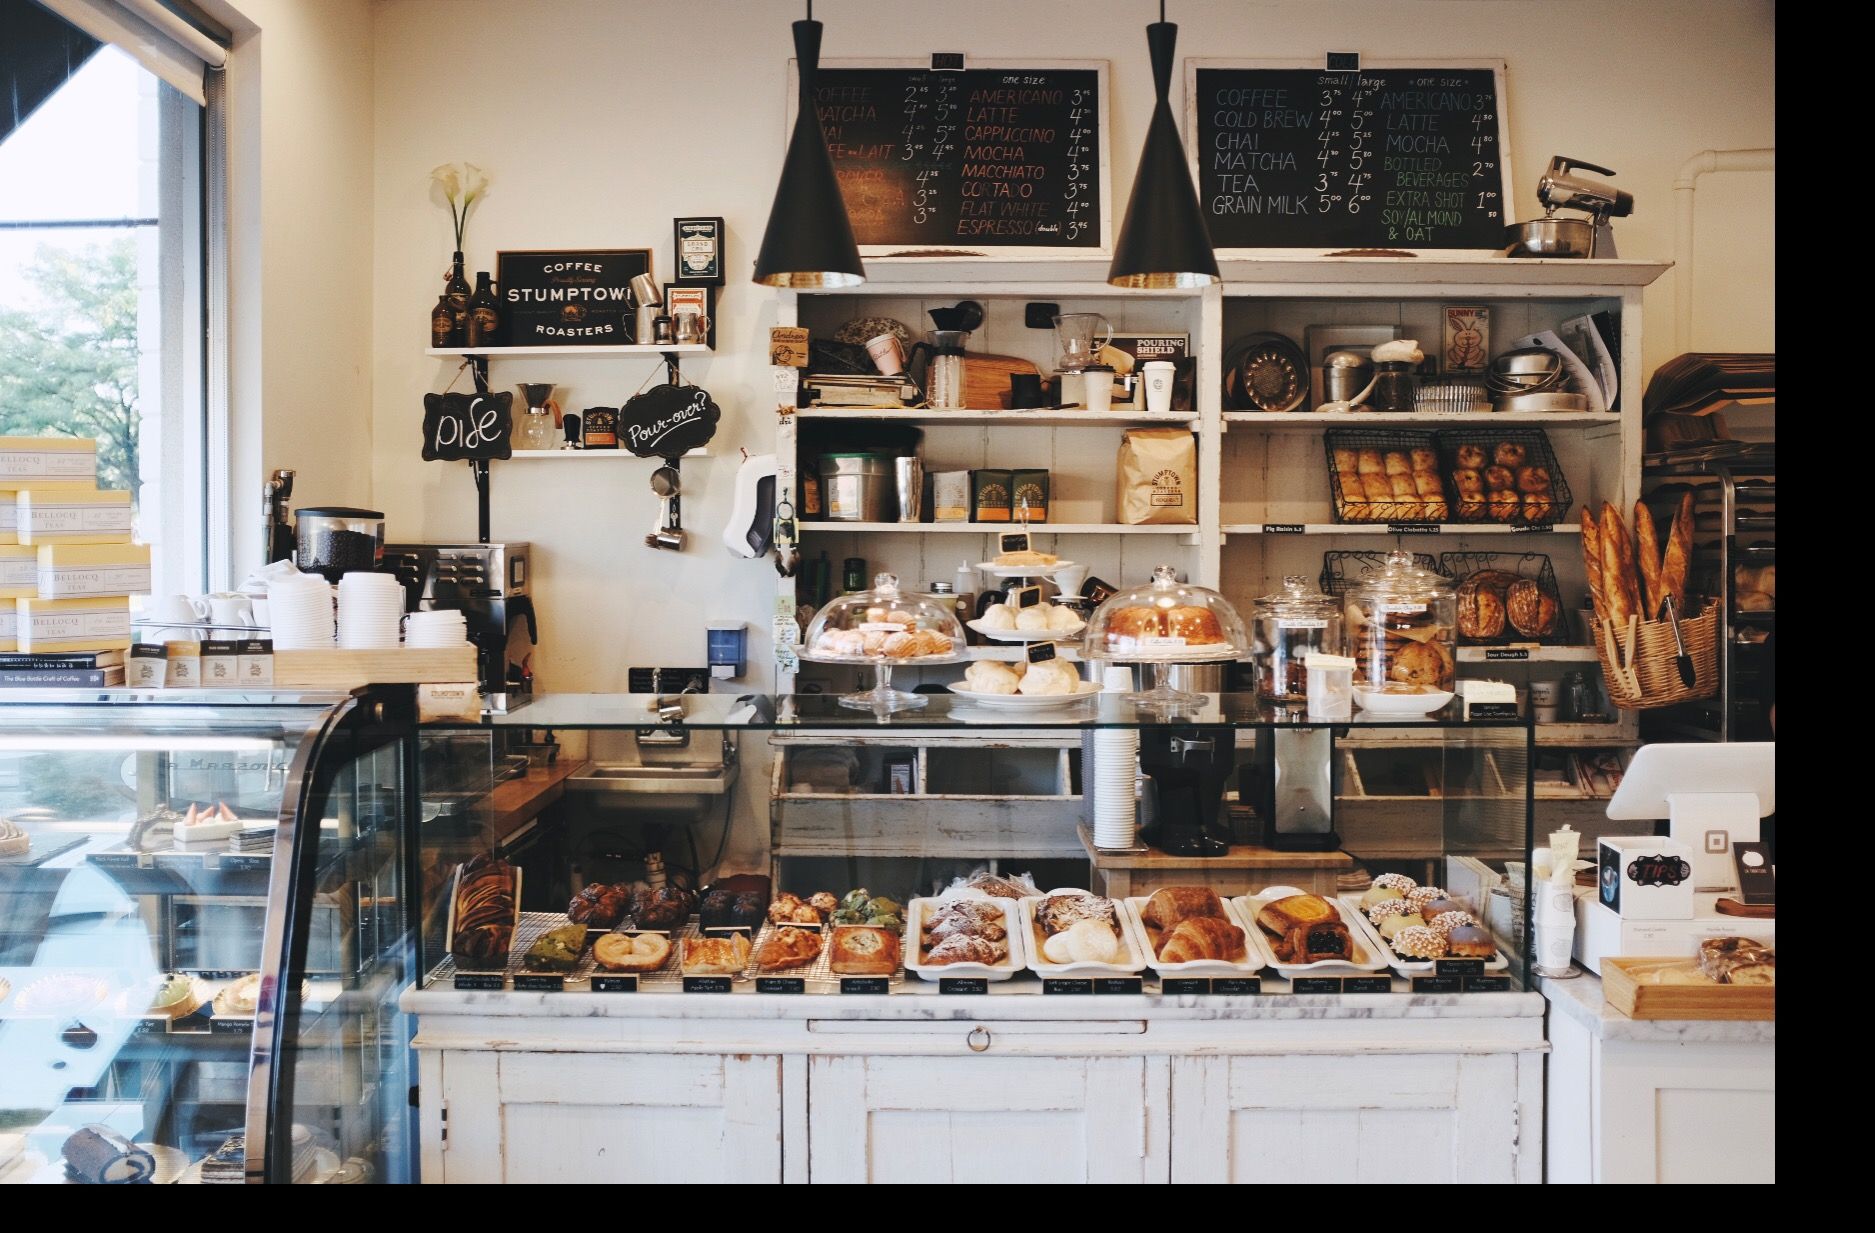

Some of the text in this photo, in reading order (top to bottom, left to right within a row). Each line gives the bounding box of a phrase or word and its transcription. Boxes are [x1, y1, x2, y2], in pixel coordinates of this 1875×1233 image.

[1002, 75, 1045, 85] one size
[1317, 73, 1387, 91] small large
[1416, 77, 1463, 87] one size
[815, 86, 873, 103] OFFEE
[969, 88, 1064, 105] AMERICANO
[1215, 88, 1289, 109] COFFEE
[1379, 91, 1472, 111] AMERICANO
[966, 106, 1020, 123] LATTE
[1213, 110, 1257, 129] COLD
[1263, 109, 1314, 129] BREW
[1385, 113, 1441, 132] LATTE
[964, 124, 1057, 144] CAPPUCCINO
[1214, 131, 1260, 151] CHAI
[1385, 134, 1451, 154] MOCHA
[963, 145, 1025, 162] MOCHA
[1213, 151, 1297, 172] MATCHA
[961, 163, 1046, 181] MACCHIATO
[1383, 156, 1443, 172] BOTTLED
[1216, 173, 1261, 193] TEA
[1396, 171, 1471, 189] BEVERAGES
[961, 181, 1033, 199] CORTADO
[1211, 194, 1262, 216] GRAIN
[1267, 194, 1310, 216] MILK
[1385, 189, 1430, 208] EXTRA
[1434, 190, 1466, 209] SHOT
[960, 200, 995, 217] FLAT
[1000, 200, 1050, 218] WHITE
[1380, 207, 1463, 229] SOY/ALMOND
[956, 219, 1034, 236] ESPRESSO
[1405, 225, 1436, 242] OAT
[543, 262, 603, 274] COFFEE
[535, 323, 614, 337] ROASTERS
[1136, 338, 1185, 347] POURING
[1136, 346, 1175, 355] SHIELD
[0, 455, 41, 465] ELLOCQ
[31, 511, 78, 520] BELLOCQ
[54, 573, 99, 583] BELLOCQ
[32, 617, 79, 626] BELLOCQ
[1642, 863, 1677, 879] TIPS
